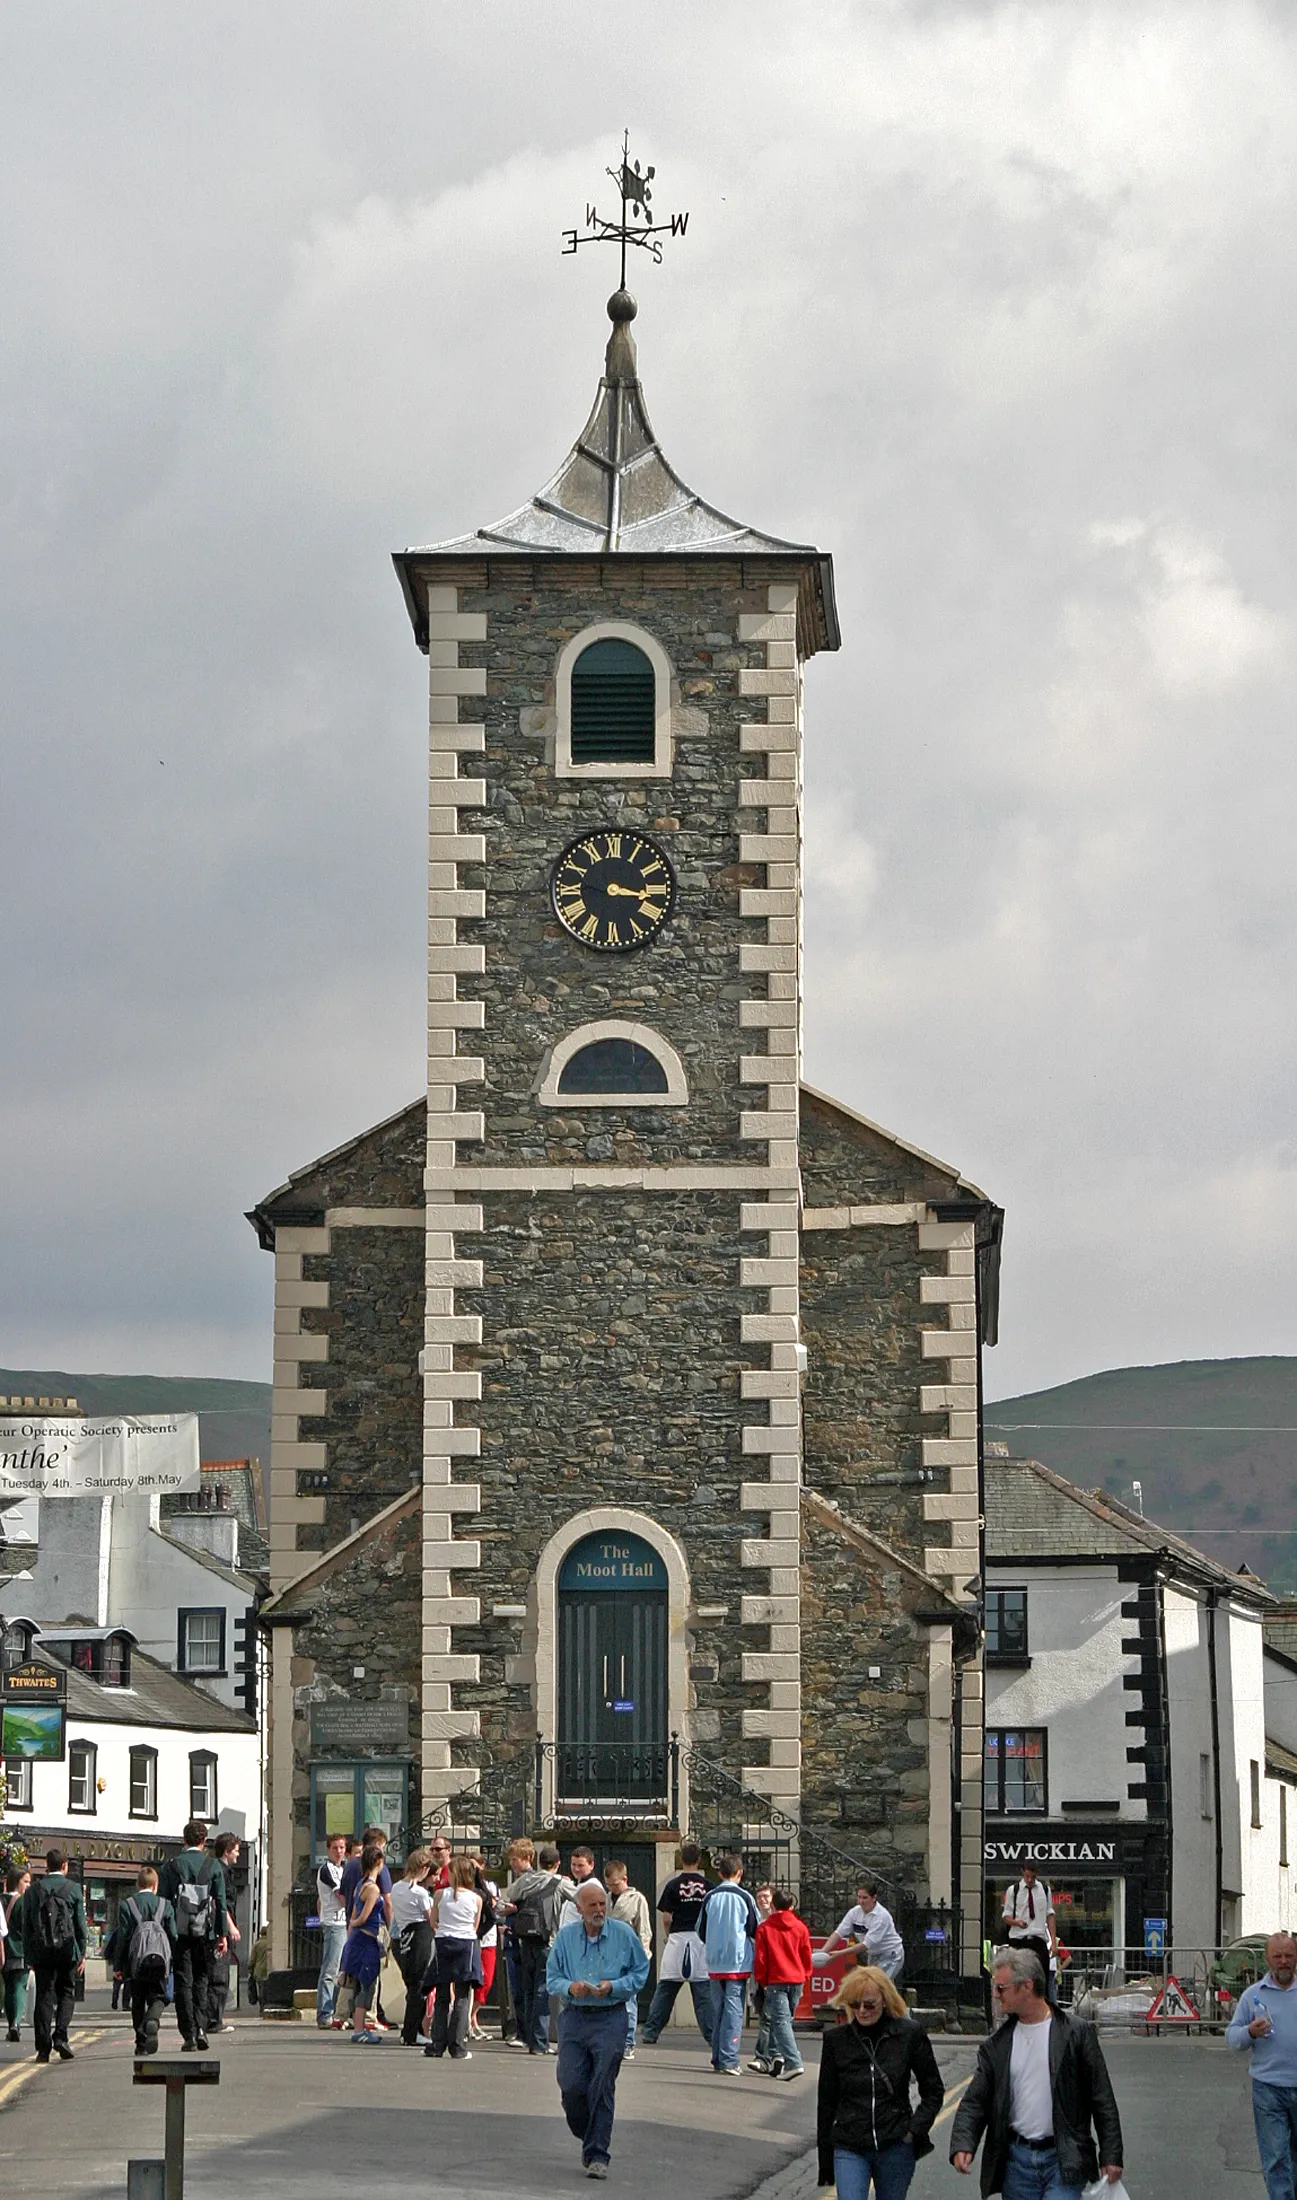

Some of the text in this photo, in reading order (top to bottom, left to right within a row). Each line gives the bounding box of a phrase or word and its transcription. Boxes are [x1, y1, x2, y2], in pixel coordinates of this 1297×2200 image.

[671, 212, 690, 237] W
[582, 842, 603, 865] XI
[605, 837, 622, 859] XII
[565, 860, 588, 878] X
[640, 859, 662, 878] II
[560, 882, 582, 896] IX
[607, 921, 619, 943] VI
[629, 917, 644, 938] V
[21, 1424, 76, 1441] Operatic
[80, 1424, 124, 1438] Society
[127, 1424, 178, 1438] presents
[2, 1478, 48, 1491] Tuesday
[52, 1478, 73, 1489] 4th.
[84, 1476, 134, 1489] Saturday
[600, 1544, 630, 1558] The
[577, 1562, 654, 1576] Moot Hall
[8, 1677, 58, 1689] THWAITES
[984, 1842, 1116, 1860] SWICKIAN
[811, 1976, 835, 1992] ED
